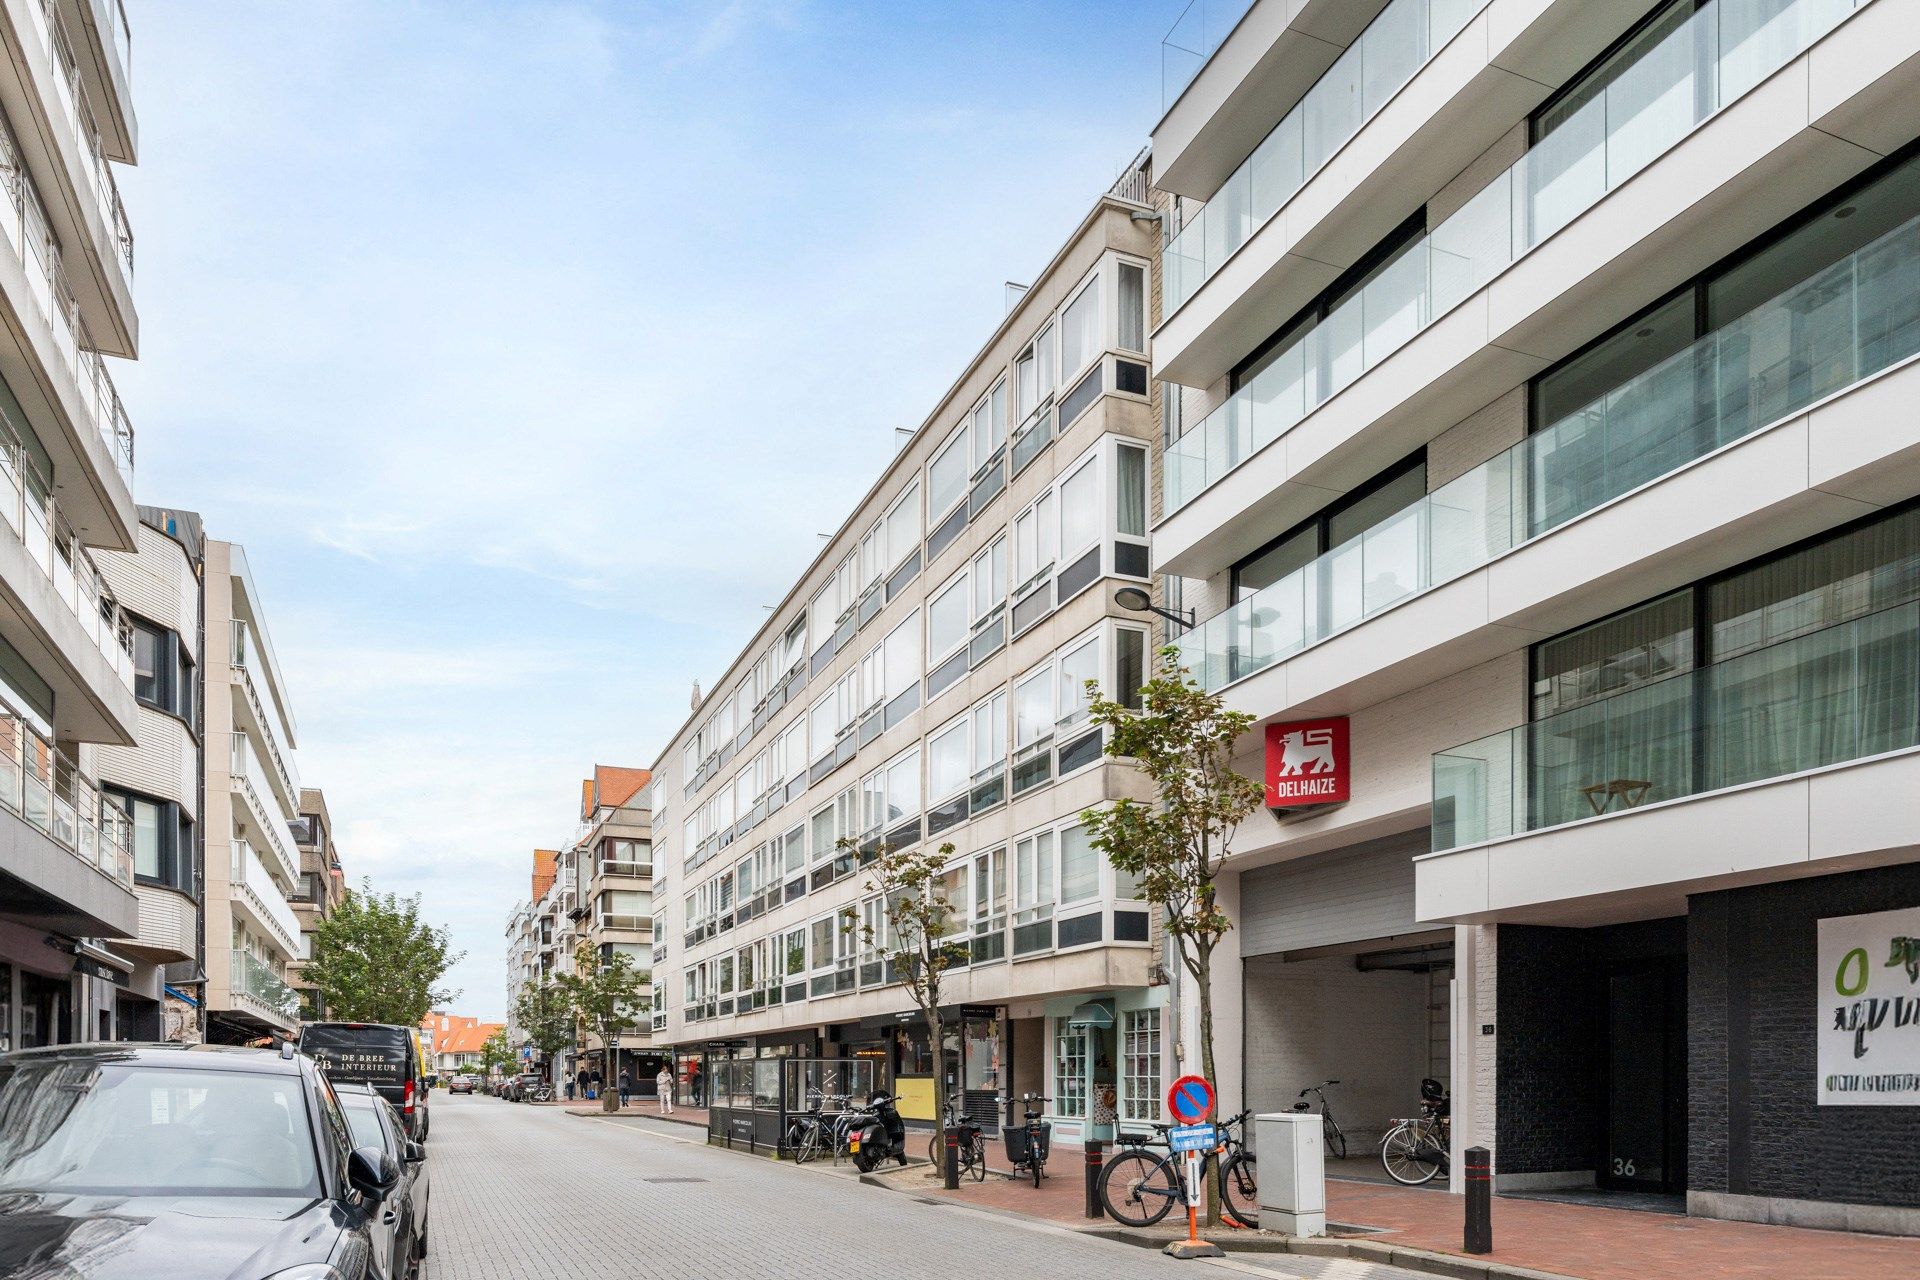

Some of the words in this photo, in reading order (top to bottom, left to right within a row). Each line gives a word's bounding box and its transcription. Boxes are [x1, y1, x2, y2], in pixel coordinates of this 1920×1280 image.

[1278, 777, 1336, 798] DELHAIZE
[359, 1054, 384, 1062] BREE
[341, 1063, 396, 1071] INTERIEUR
[1613, 1157, 1636, 1177] 36
